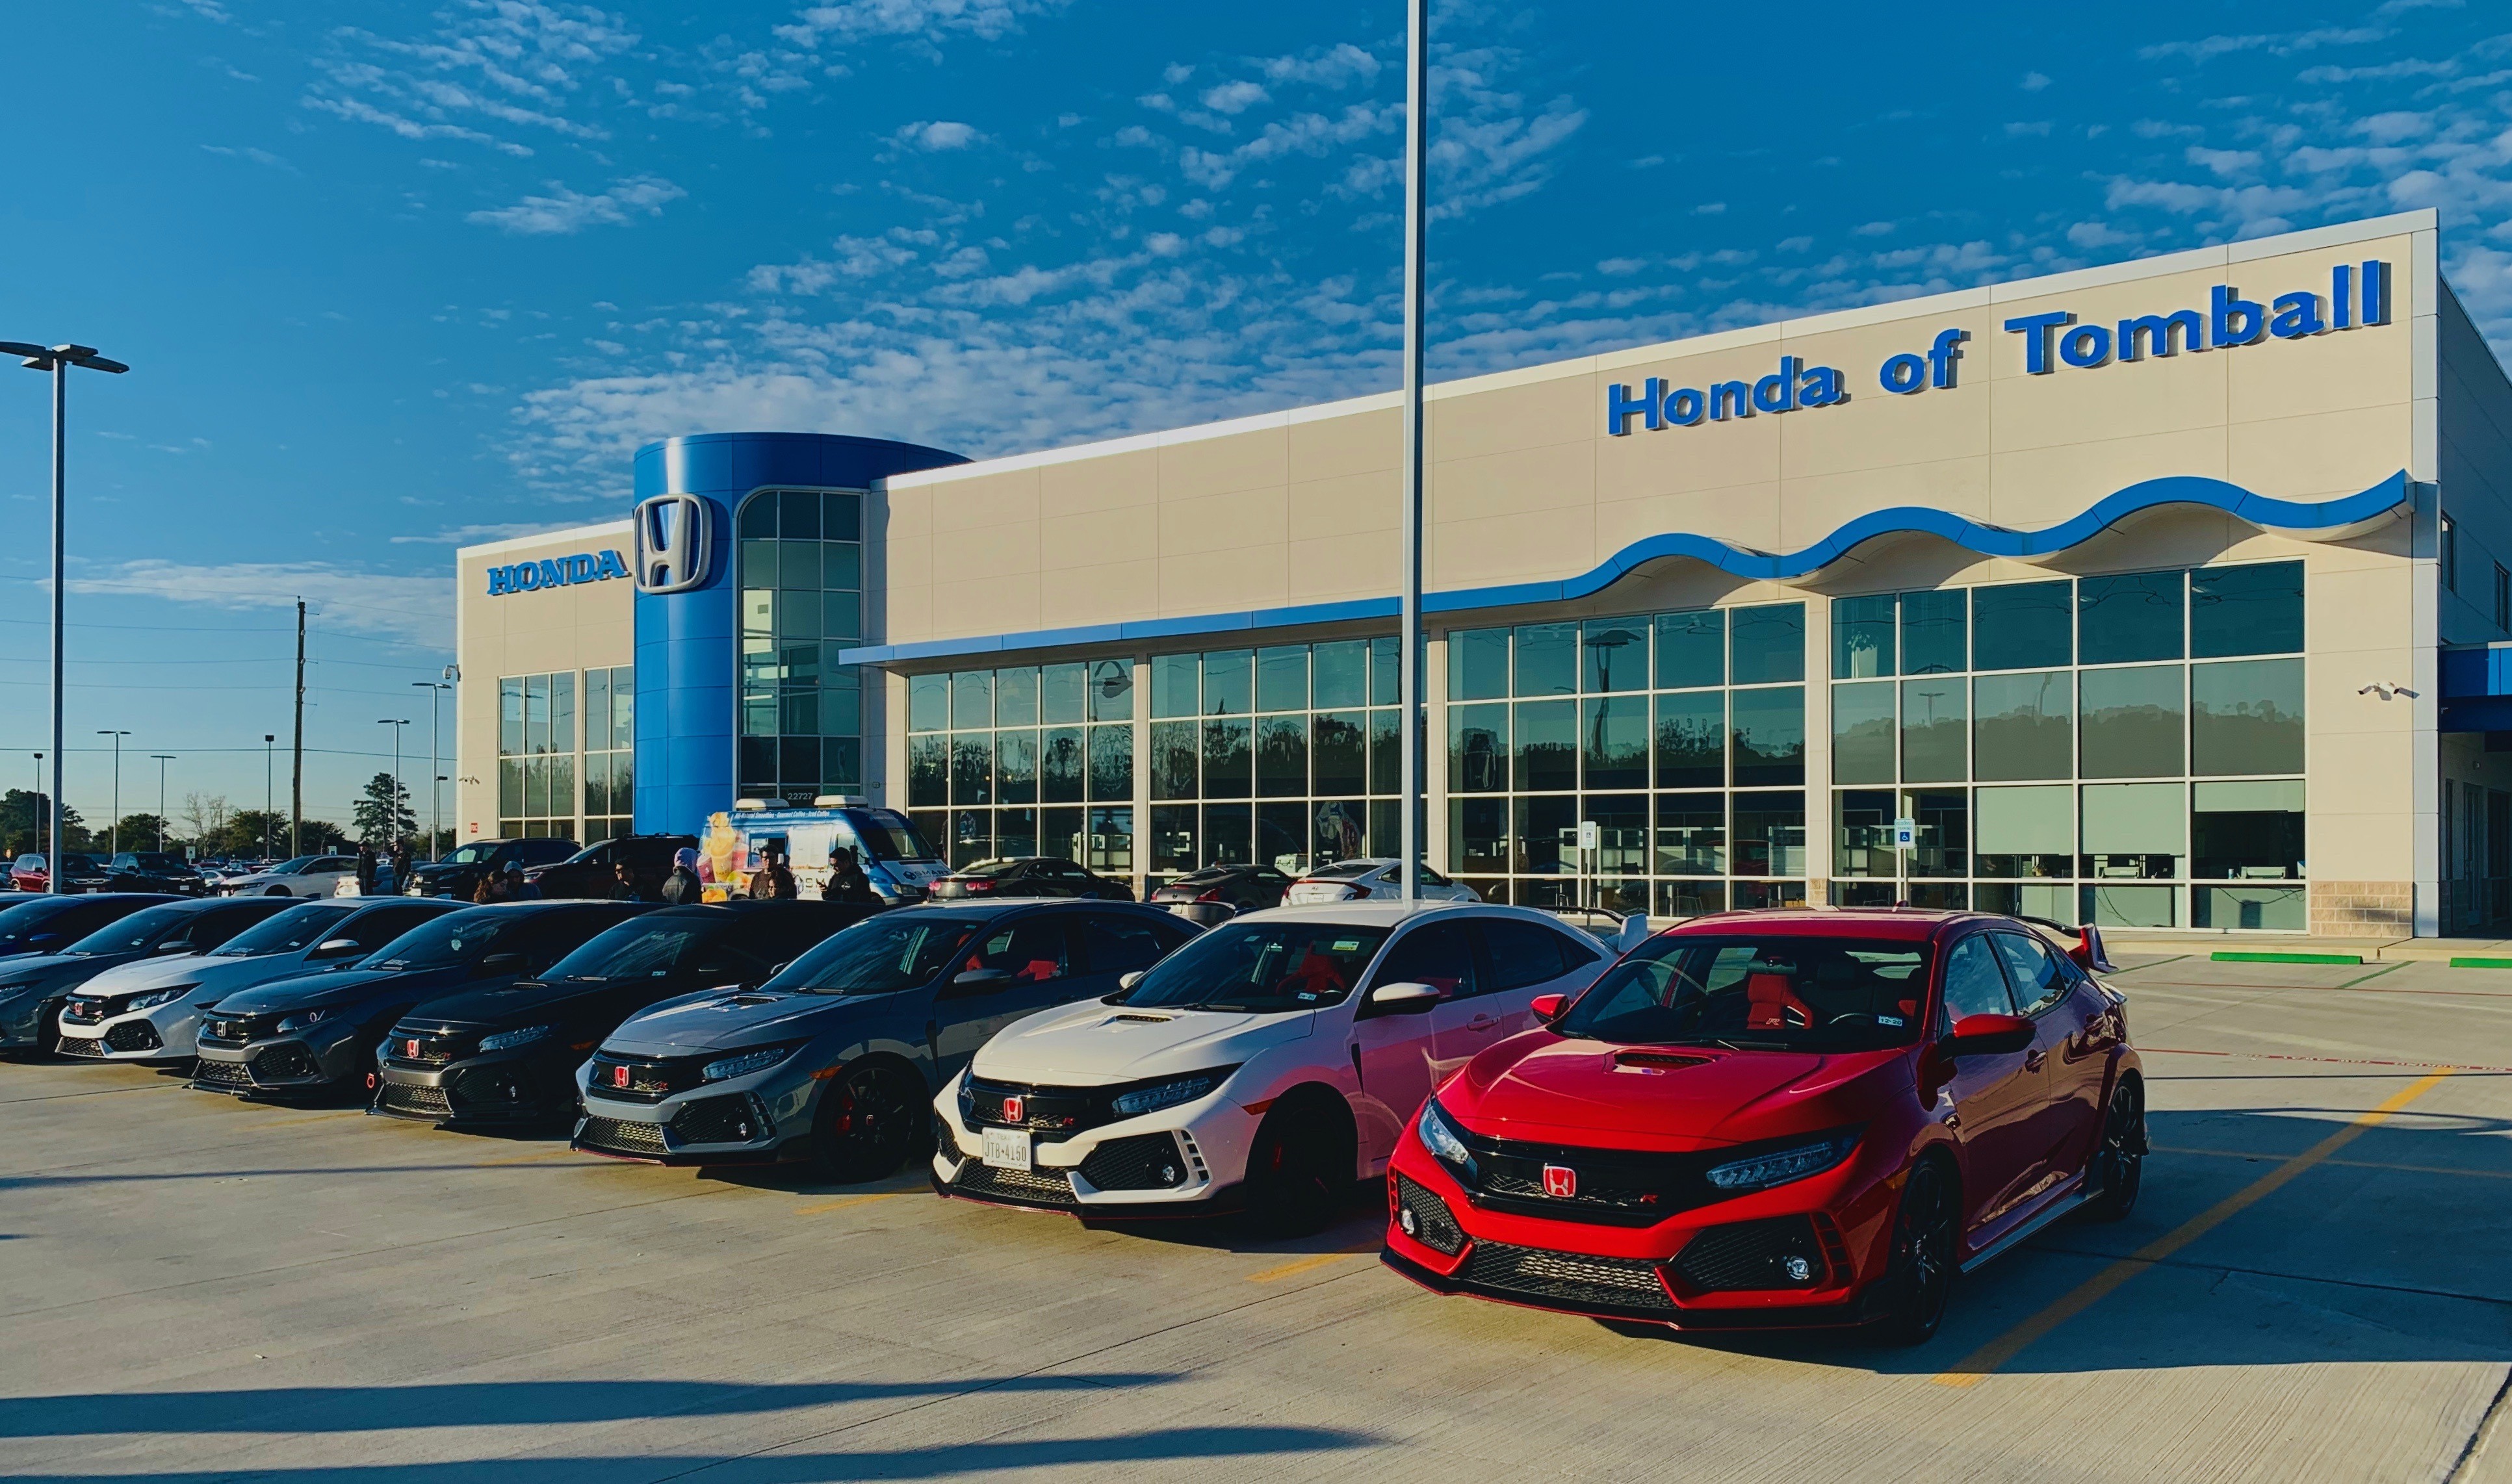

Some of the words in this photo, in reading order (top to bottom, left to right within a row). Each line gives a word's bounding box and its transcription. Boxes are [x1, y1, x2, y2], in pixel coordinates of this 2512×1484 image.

[1608, 356, 1843, 437] Honda
[1880, 330, 1967, 394] of
[2004, 261, 2391, 375] Tomball
[487, 550, 630, 596] HONDA
